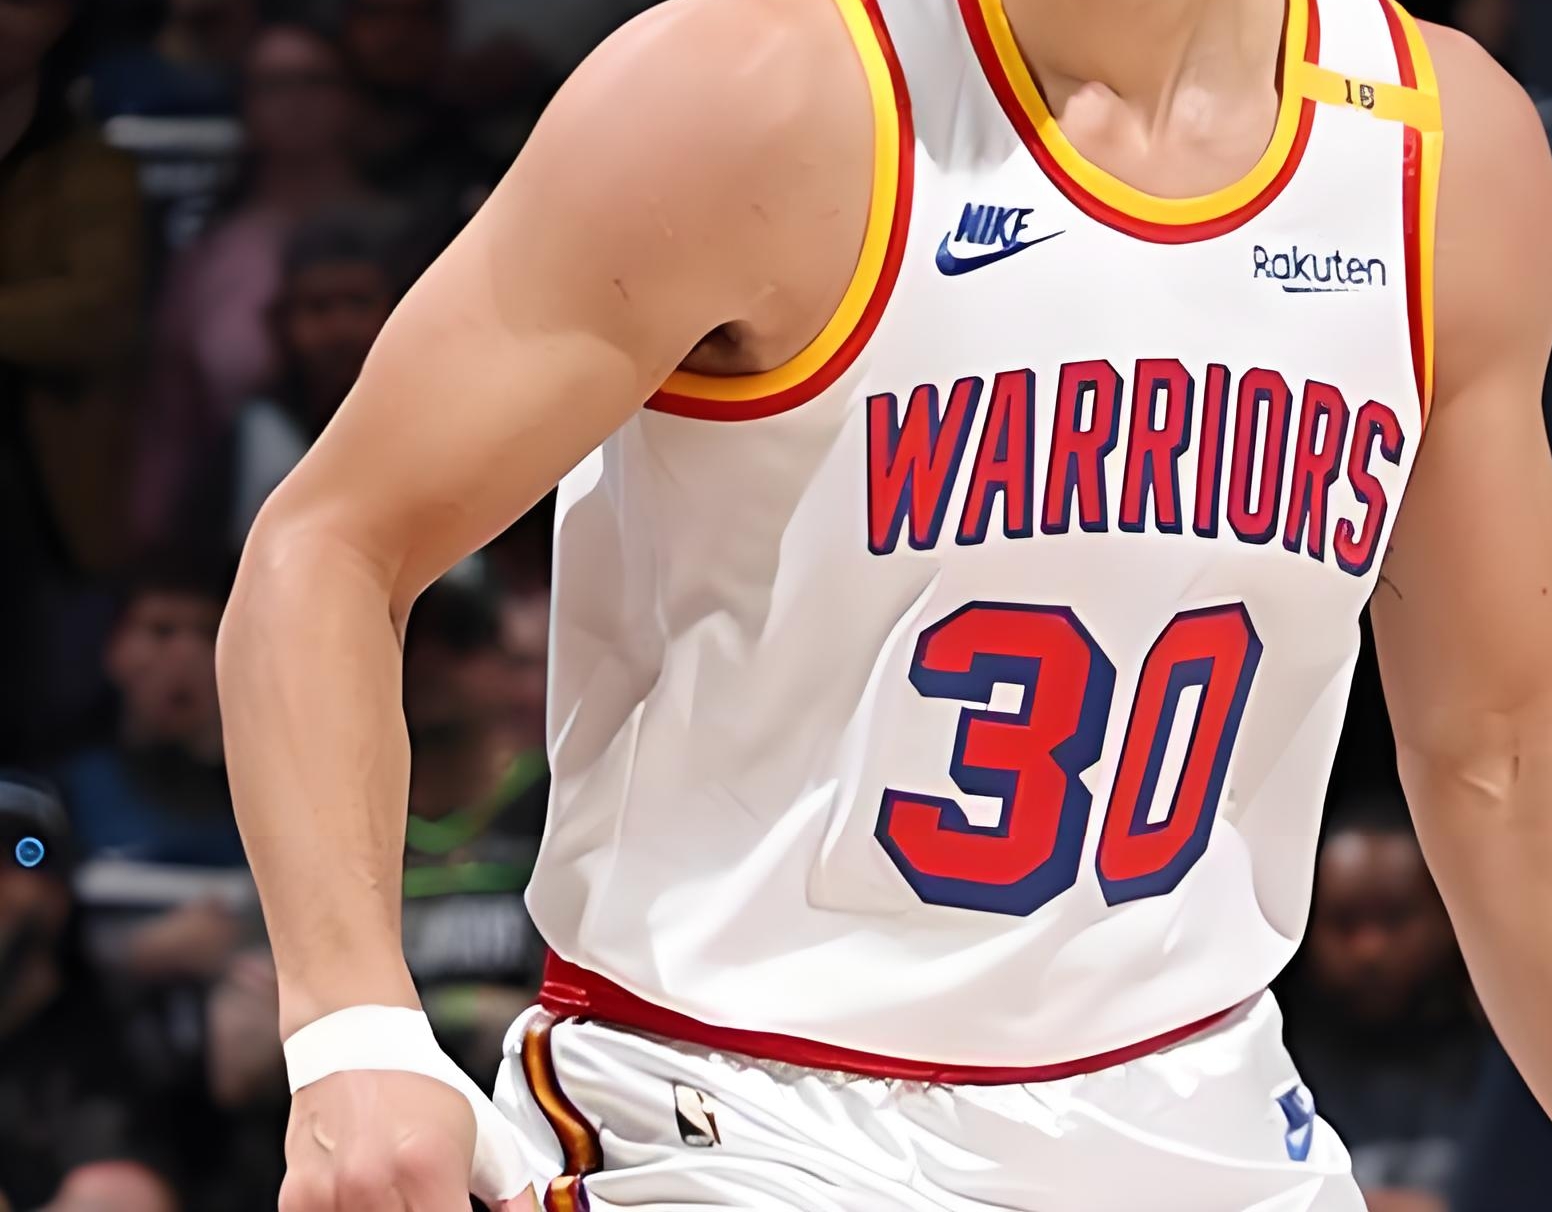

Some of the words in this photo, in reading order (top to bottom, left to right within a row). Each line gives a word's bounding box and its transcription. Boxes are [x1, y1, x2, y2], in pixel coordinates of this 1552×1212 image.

[954, 202, 1034, 248] NIKE
[1253, 245, 1387, 286] Rakuten
[866, 358, 1406, 577] WARRIORS
[873, 600, 1264, 917] 30
